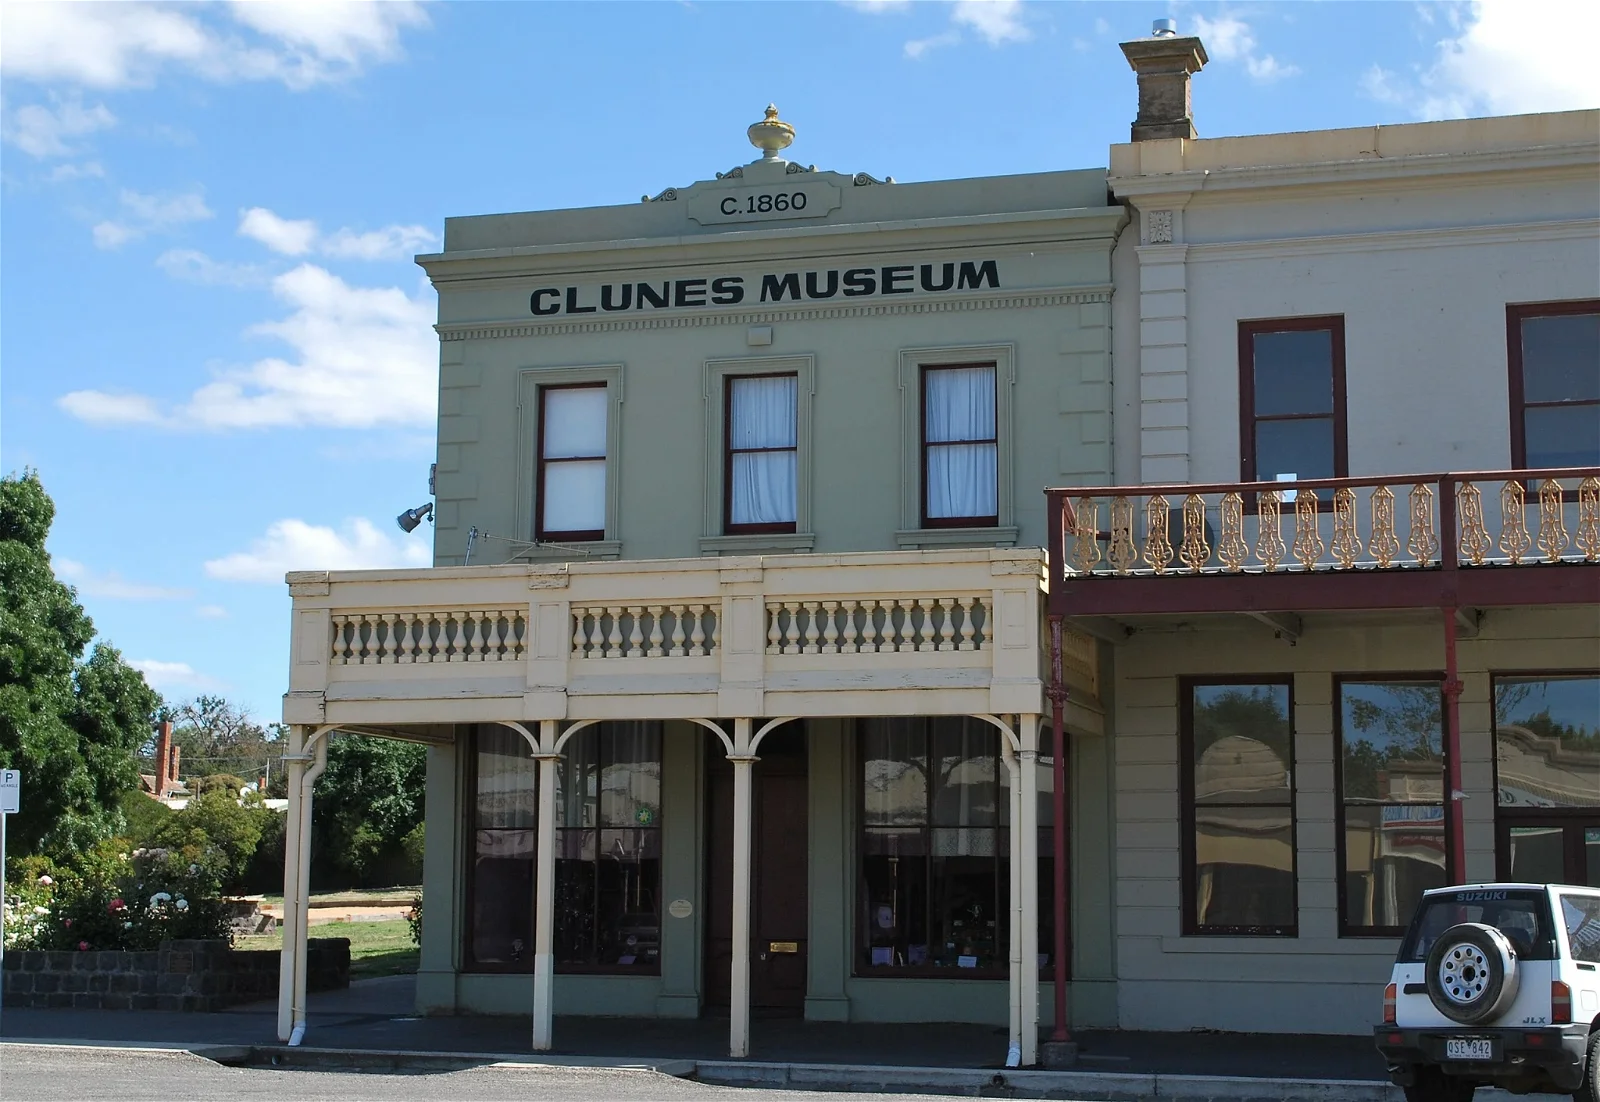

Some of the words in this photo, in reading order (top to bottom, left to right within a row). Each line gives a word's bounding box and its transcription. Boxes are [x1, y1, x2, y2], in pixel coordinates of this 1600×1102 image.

[720, 192, 807, 216] C.1860
[530, 278, 745, 316] CLUNES
[760, 260, 1000, 303] MUSEUM
[6, 773, 13, 783] P
[1456, 891, 1507, 901] SUZUKI
[1448, 1041, 1466, 1054] QSE
[1472, 1041, 1490, 1054] 842
